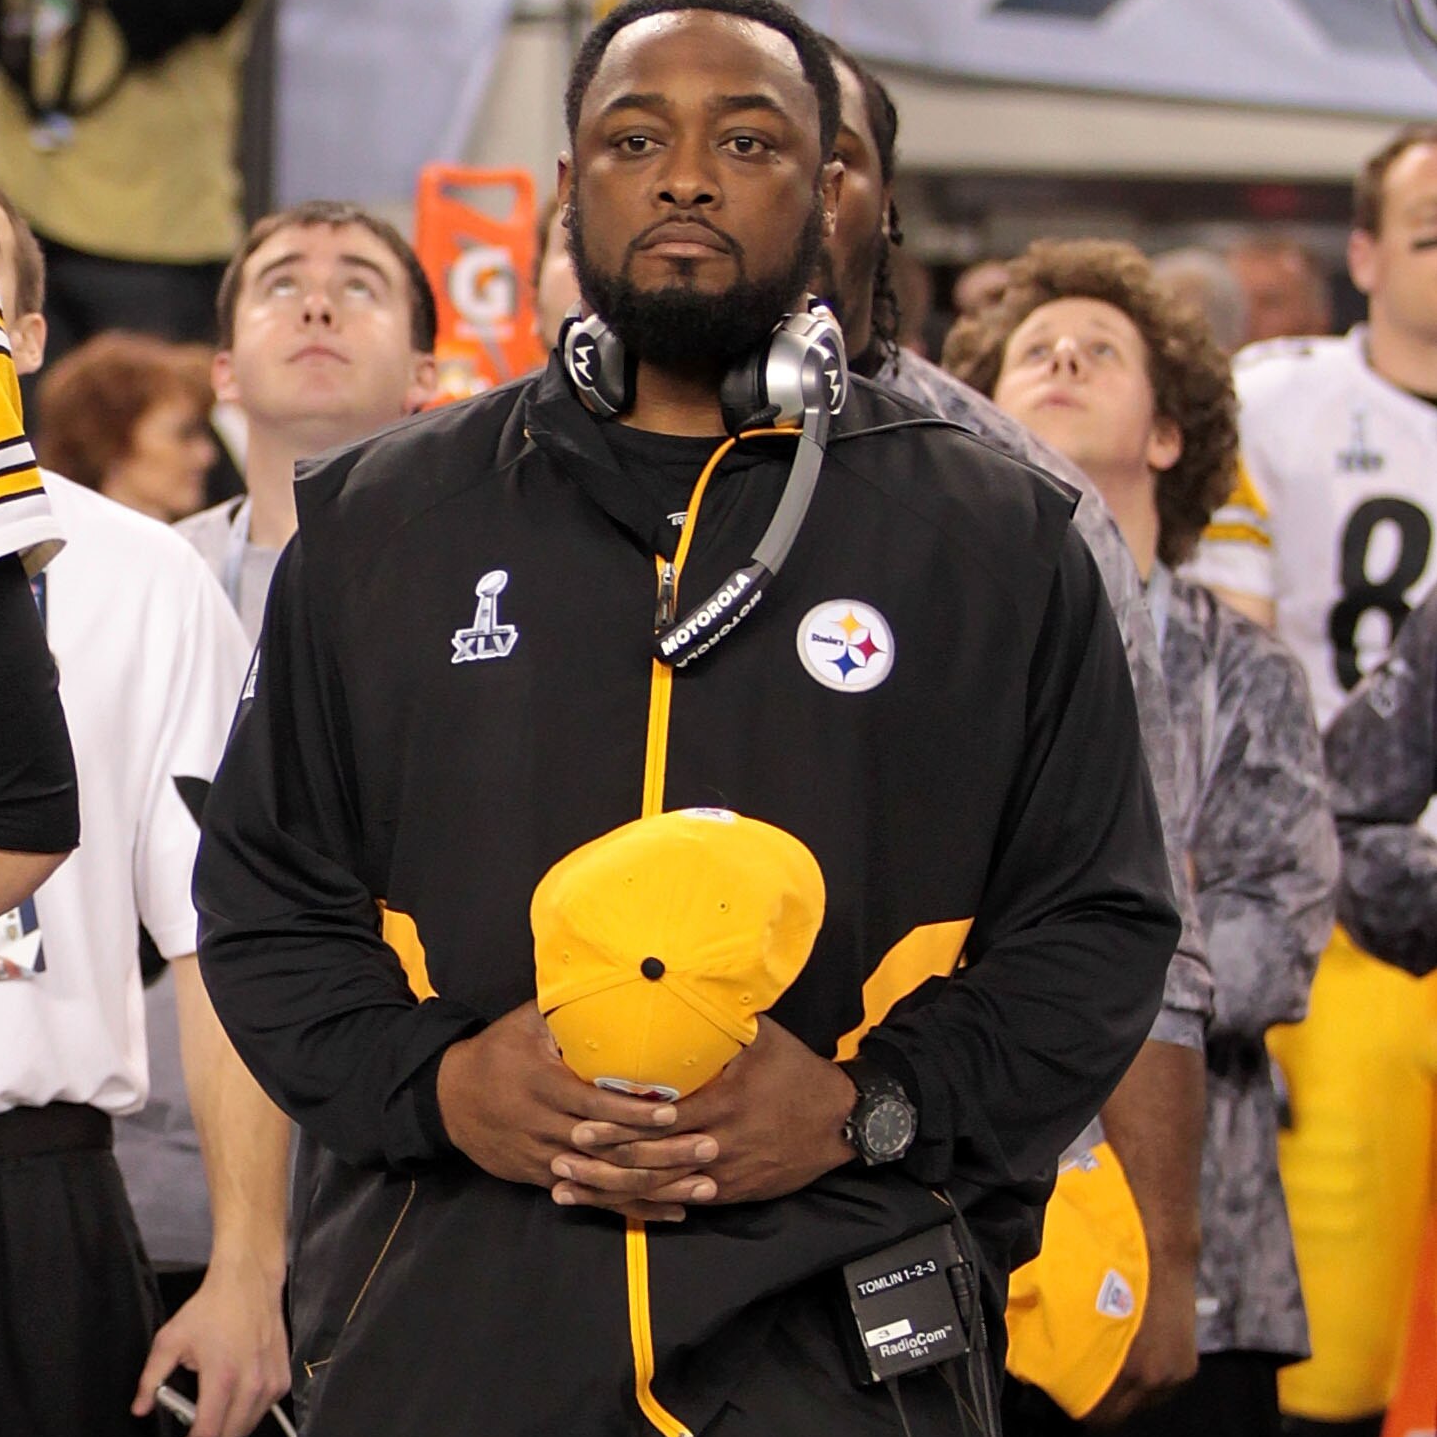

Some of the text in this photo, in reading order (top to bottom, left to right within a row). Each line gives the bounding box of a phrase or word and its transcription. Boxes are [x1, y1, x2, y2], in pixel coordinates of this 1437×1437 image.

[447, 246, 516, 324] G
[660, 572, 751, 656] MOTOROLA
[452, 633, 517, 662] XLV
[857, 1260, 937, 1296] TOMLIN 1-2-3
[908, 1347, 930, 1359] TR-1
